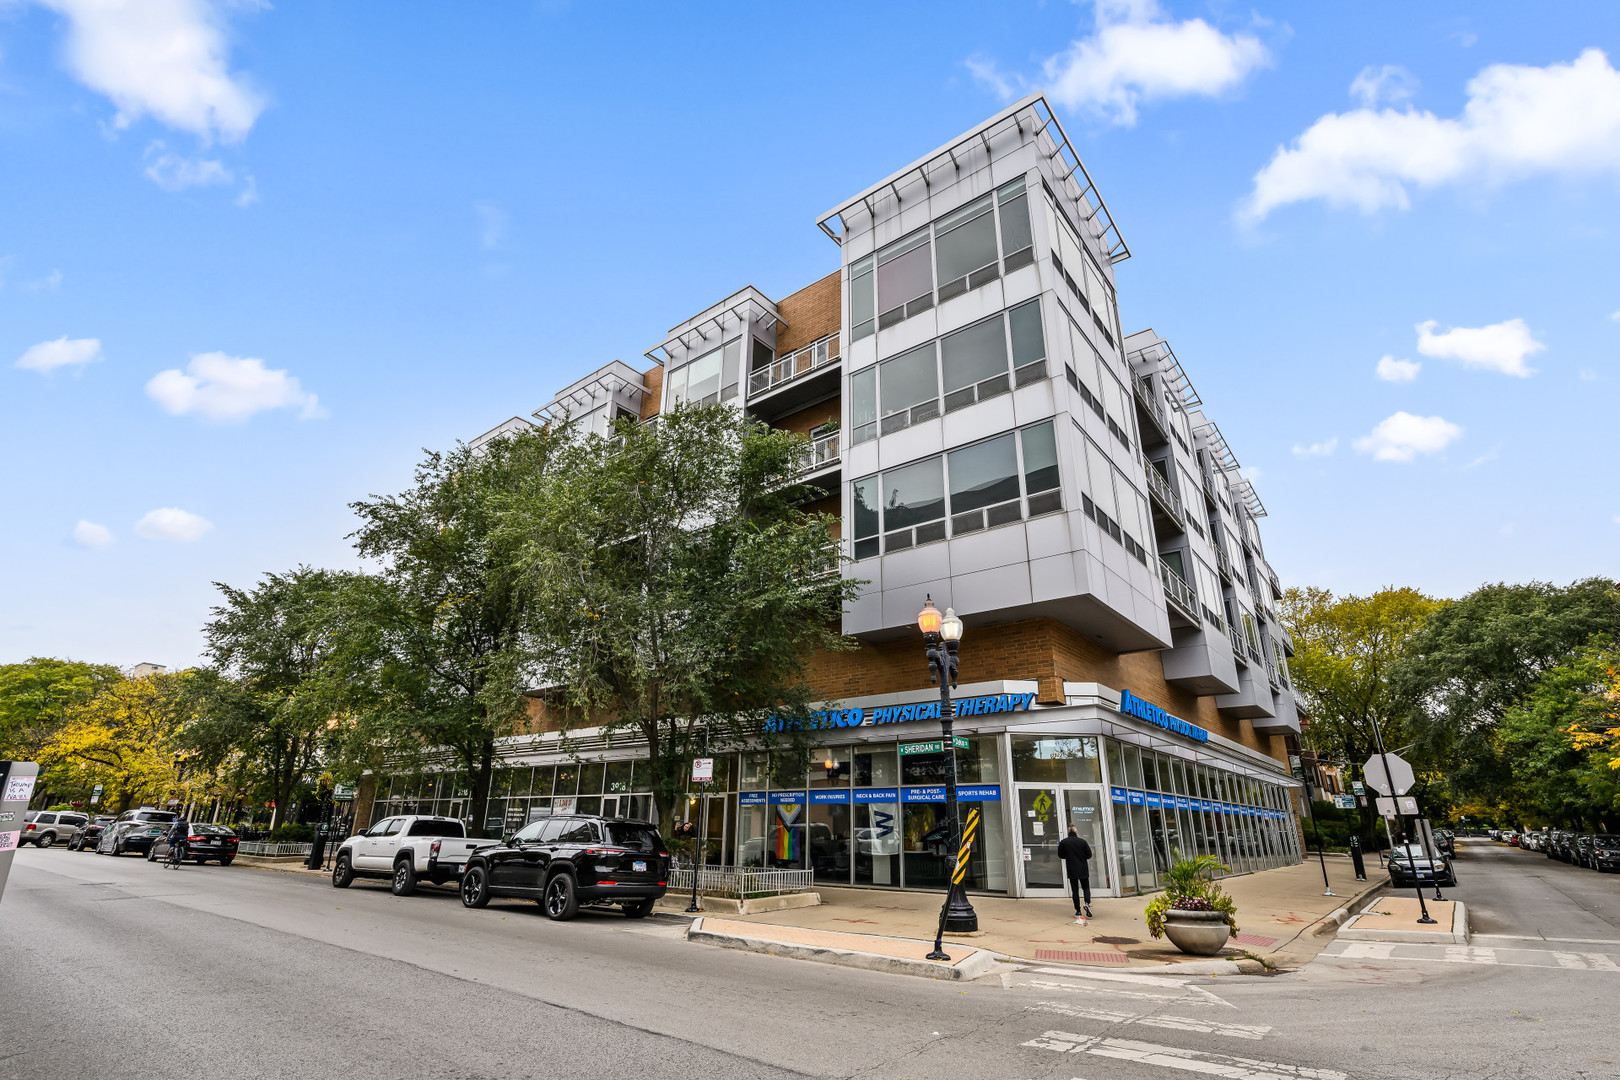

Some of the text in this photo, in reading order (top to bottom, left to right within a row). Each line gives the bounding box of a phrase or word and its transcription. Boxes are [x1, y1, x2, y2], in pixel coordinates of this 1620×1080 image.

[872, 702, 942, 724] PHYSICAL
[954, 692, 1035, 717] THERAPY
[1121, 689, 1168, 728] ATHLETICO
[904, 744, 933, 754] SHERIDAN
